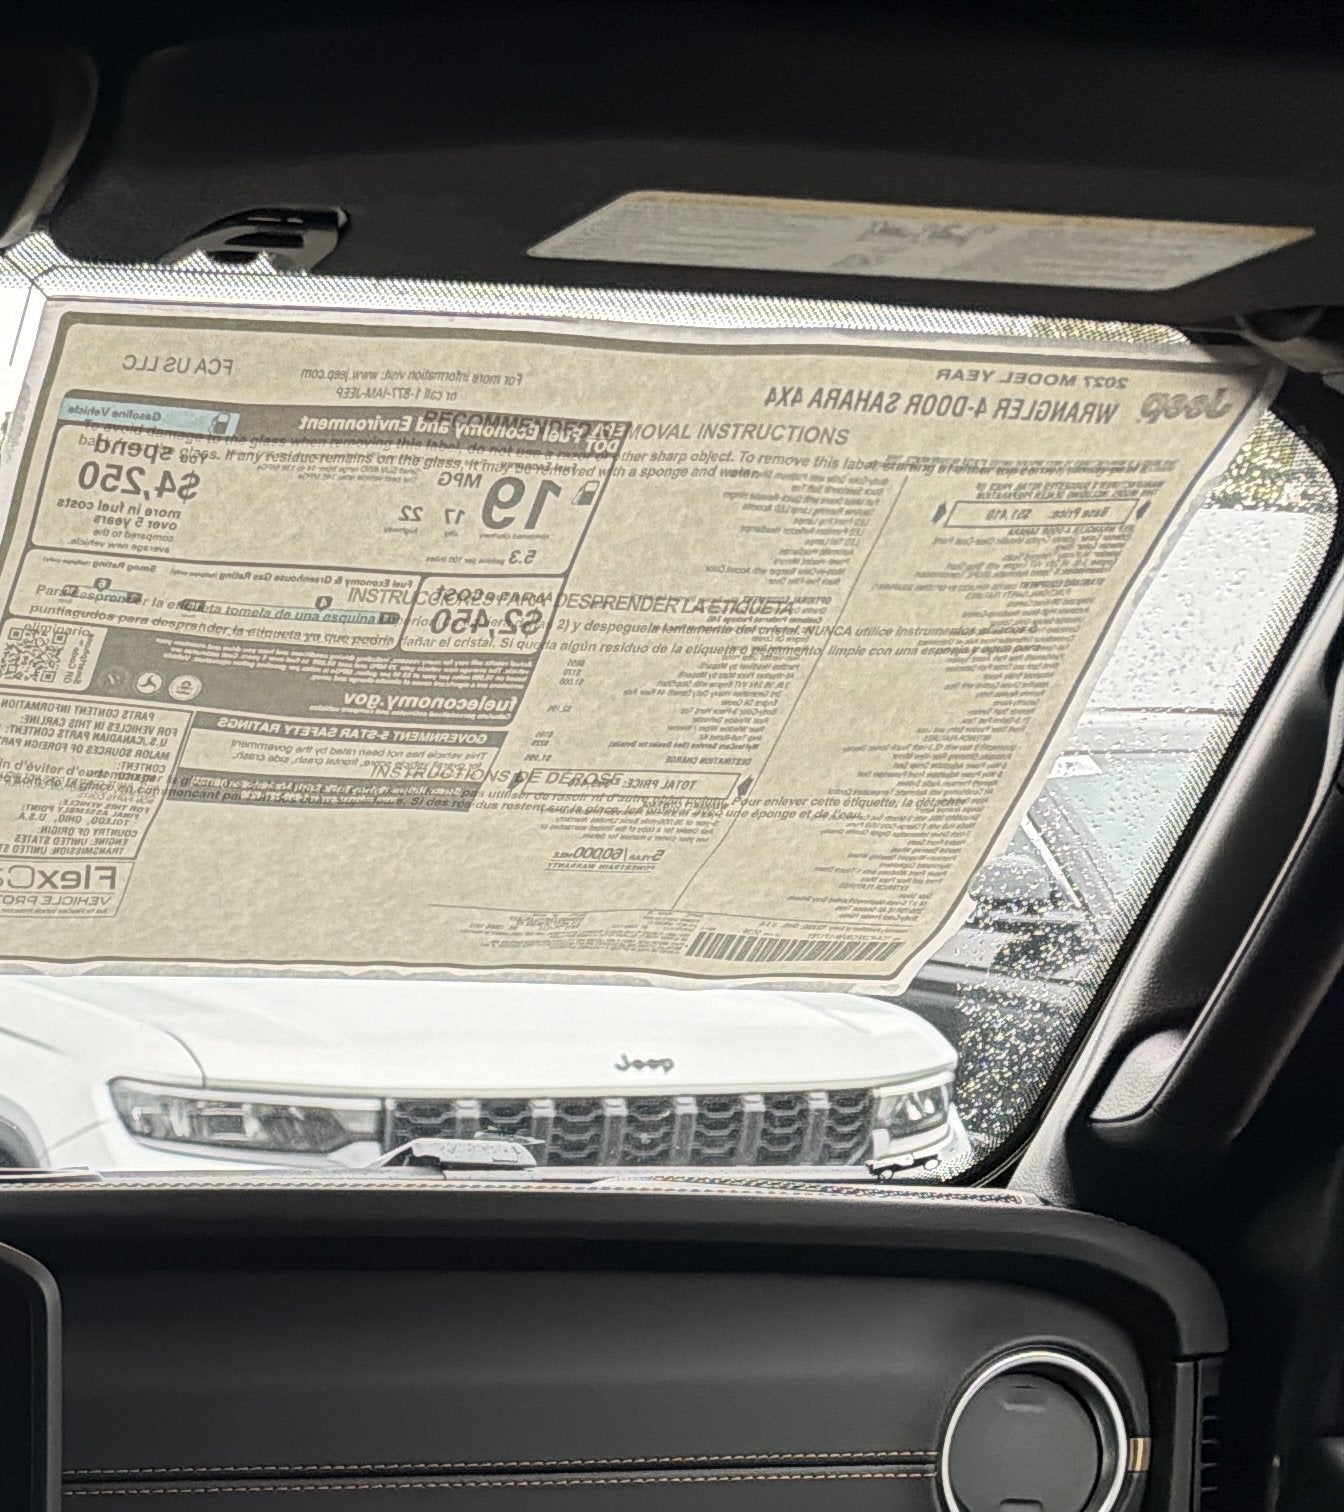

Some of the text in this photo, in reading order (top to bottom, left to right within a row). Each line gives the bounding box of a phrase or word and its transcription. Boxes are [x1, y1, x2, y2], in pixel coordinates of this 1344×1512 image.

[697, 422, 851, 447] INSTRUCTIONS
[650, 451, 839, 468] sharp remove this
[640, 465, 718, 479] sponge and
[614, 1053, 674, 1073] Jeep
